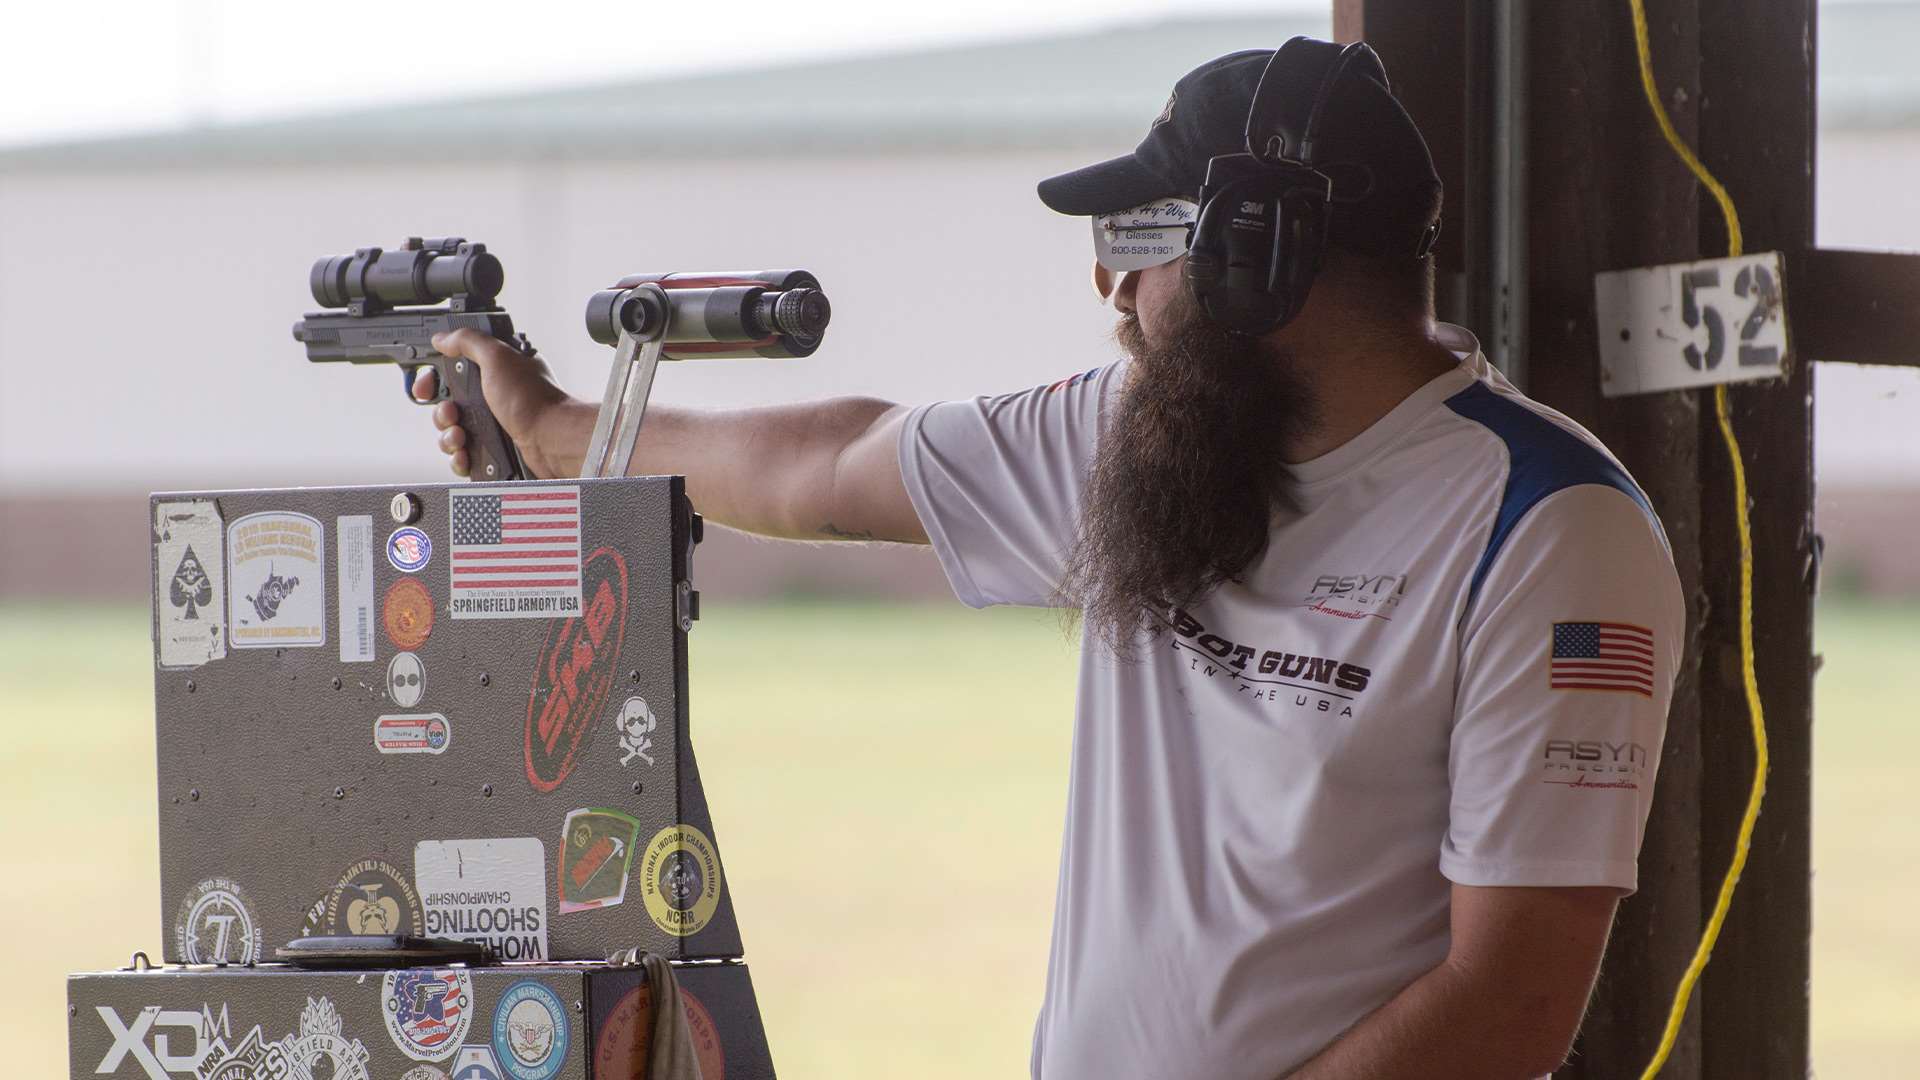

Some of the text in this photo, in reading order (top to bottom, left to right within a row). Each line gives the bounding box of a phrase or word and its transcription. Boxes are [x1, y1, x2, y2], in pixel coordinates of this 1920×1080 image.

[1240, 200, 1264, 215] 3M
[1125, 230, 1164, 240] Glasses
[1681, 263, 1778, 371] 52
[453, 596, 579, 613] SPRINGFIELD ARMORY USA
[1259, 649, 1372, 692] GUNS
[1191, 657, 1353, 718] IN THE USA
[644, 852, 660, 895] NATIONAL
[657, 832, 685, 852] INDOOR
[685, 833, 716, 900] CHAMPIONSHIPS
[425, 891, 511, 906] CHAMPIONSHIP
[426, 906, 540, 934] SHOOTING
[666, 910, 696, 924] NCRR
[197, 1046, 226, 1078] NRA
[339, 1048, 364, 1080] ARM
[511, 1062, 548, 1080] PROGRAM
